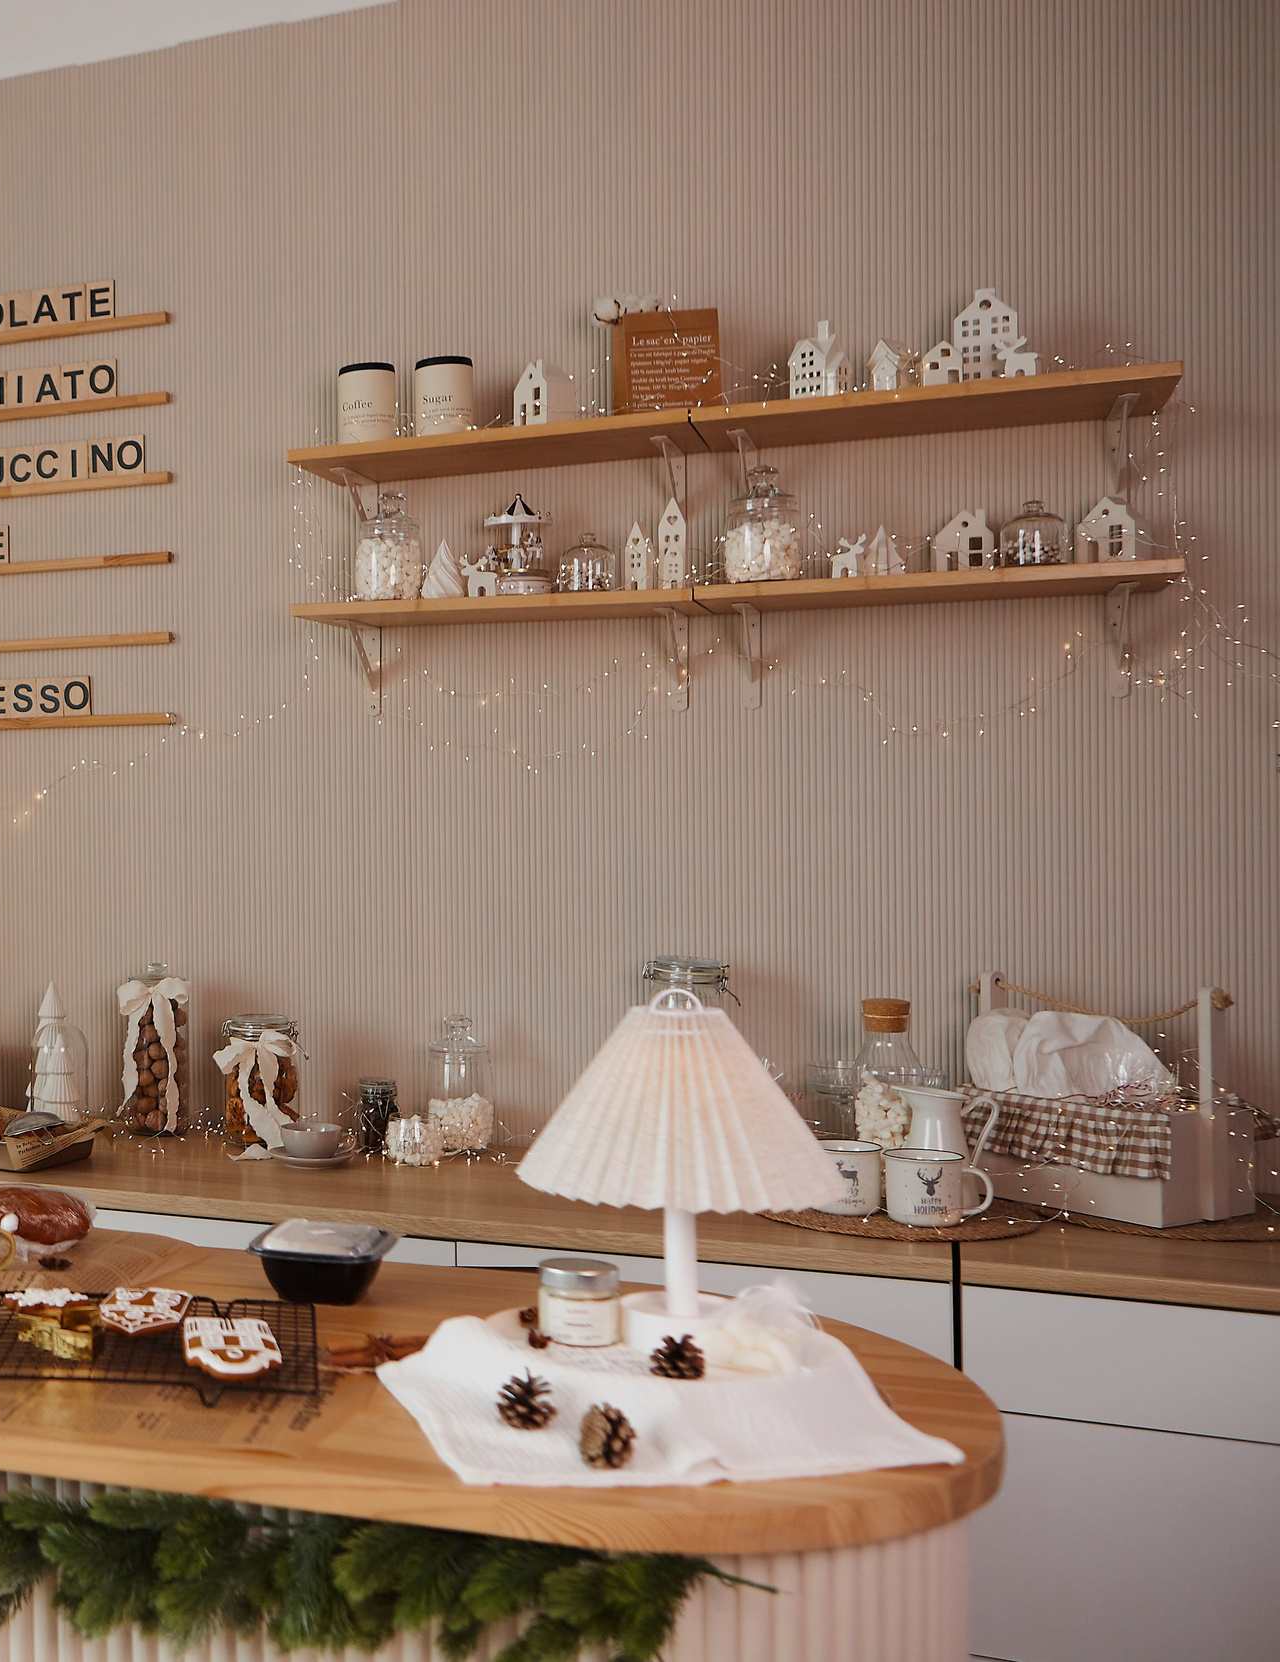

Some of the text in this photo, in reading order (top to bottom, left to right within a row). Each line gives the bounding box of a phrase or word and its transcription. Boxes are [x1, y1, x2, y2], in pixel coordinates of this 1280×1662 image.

[632, 334, 711, 346] Le sac en papier
[342, 399, 373, 411] Coffee
[422, 394, 454, 405] Sugar
[921, 1197, 942, 1205] HAPPY
